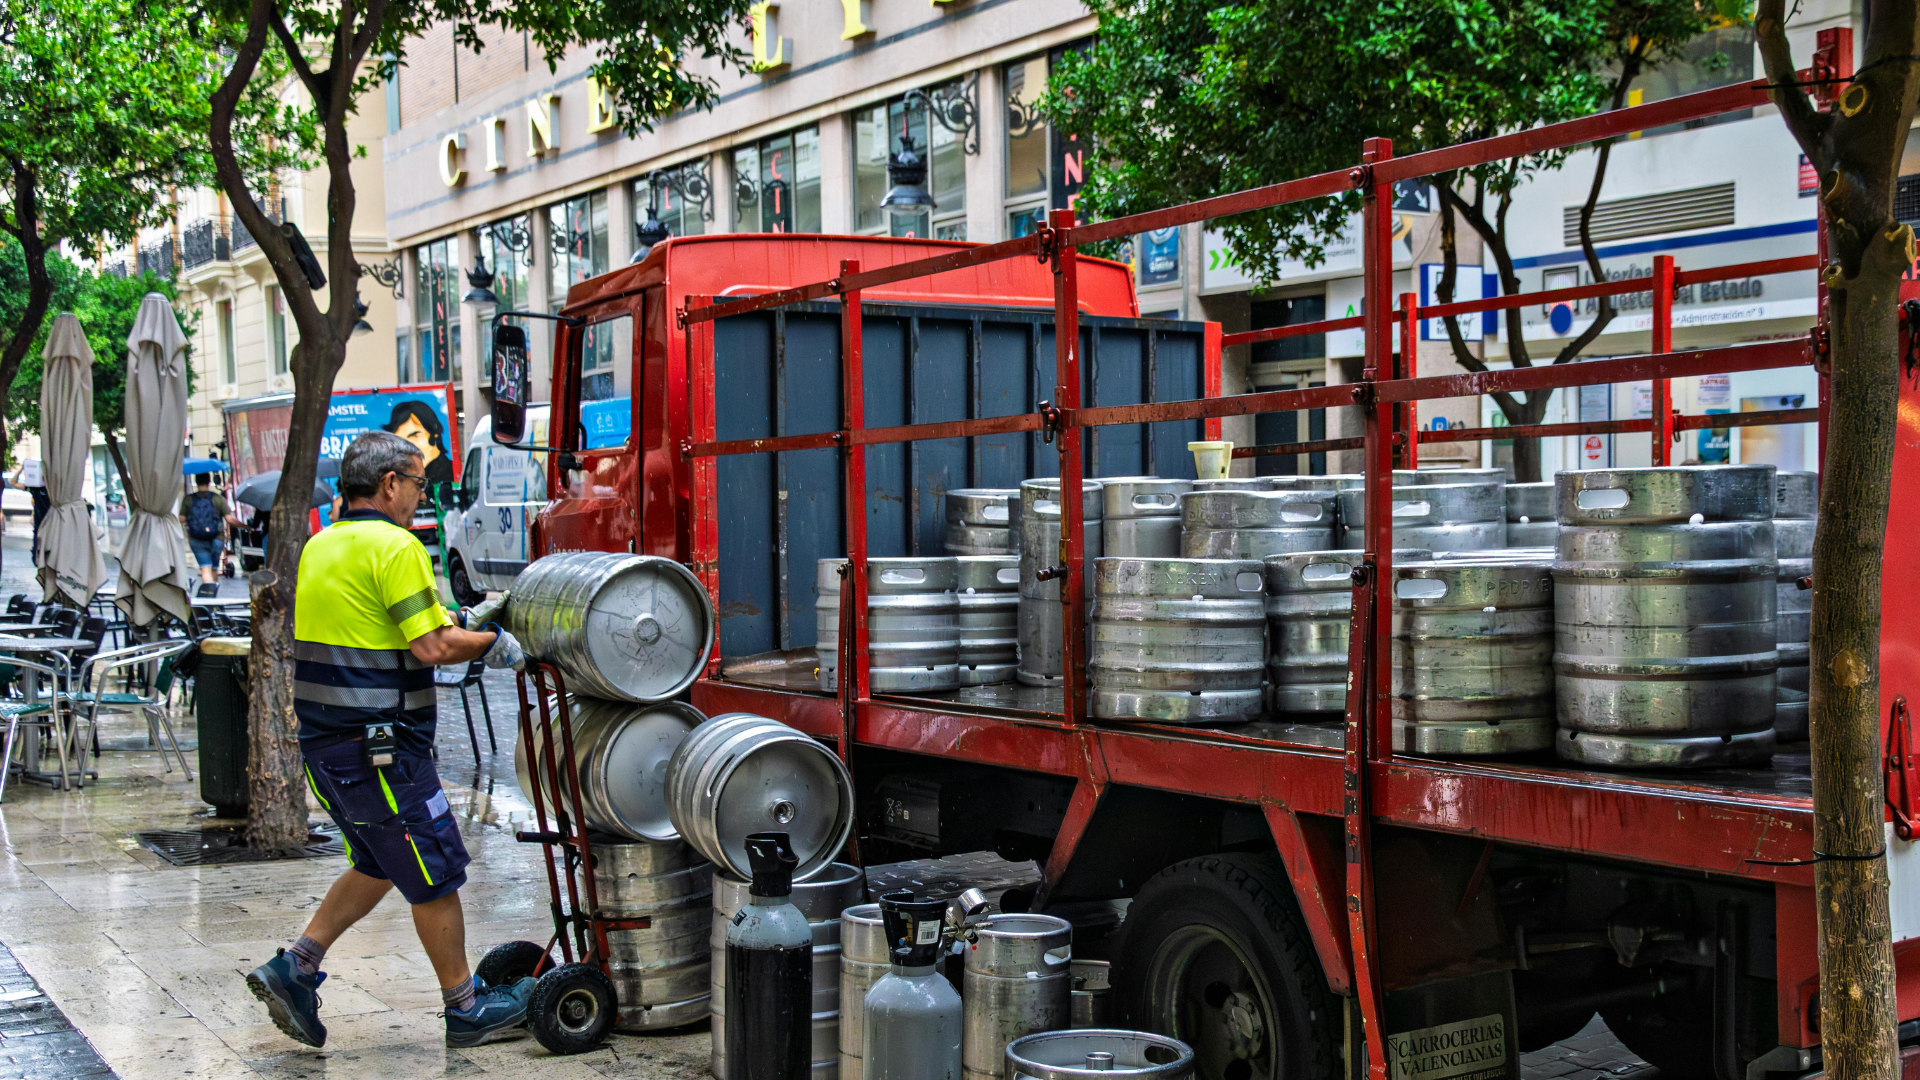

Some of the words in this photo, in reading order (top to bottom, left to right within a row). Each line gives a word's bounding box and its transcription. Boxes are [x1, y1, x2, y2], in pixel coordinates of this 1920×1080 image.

[1701, 277, 1763, 302] Estado
[435, 253, 446, 369] CINES
[1680, 309, 1743, 324] Administración
[498, 507, 512, 534] 30
[1398, 1022, 1503, 1058] CARROCERIAS
[1400, 1043, 1503, 1076] VALENCIANAS
